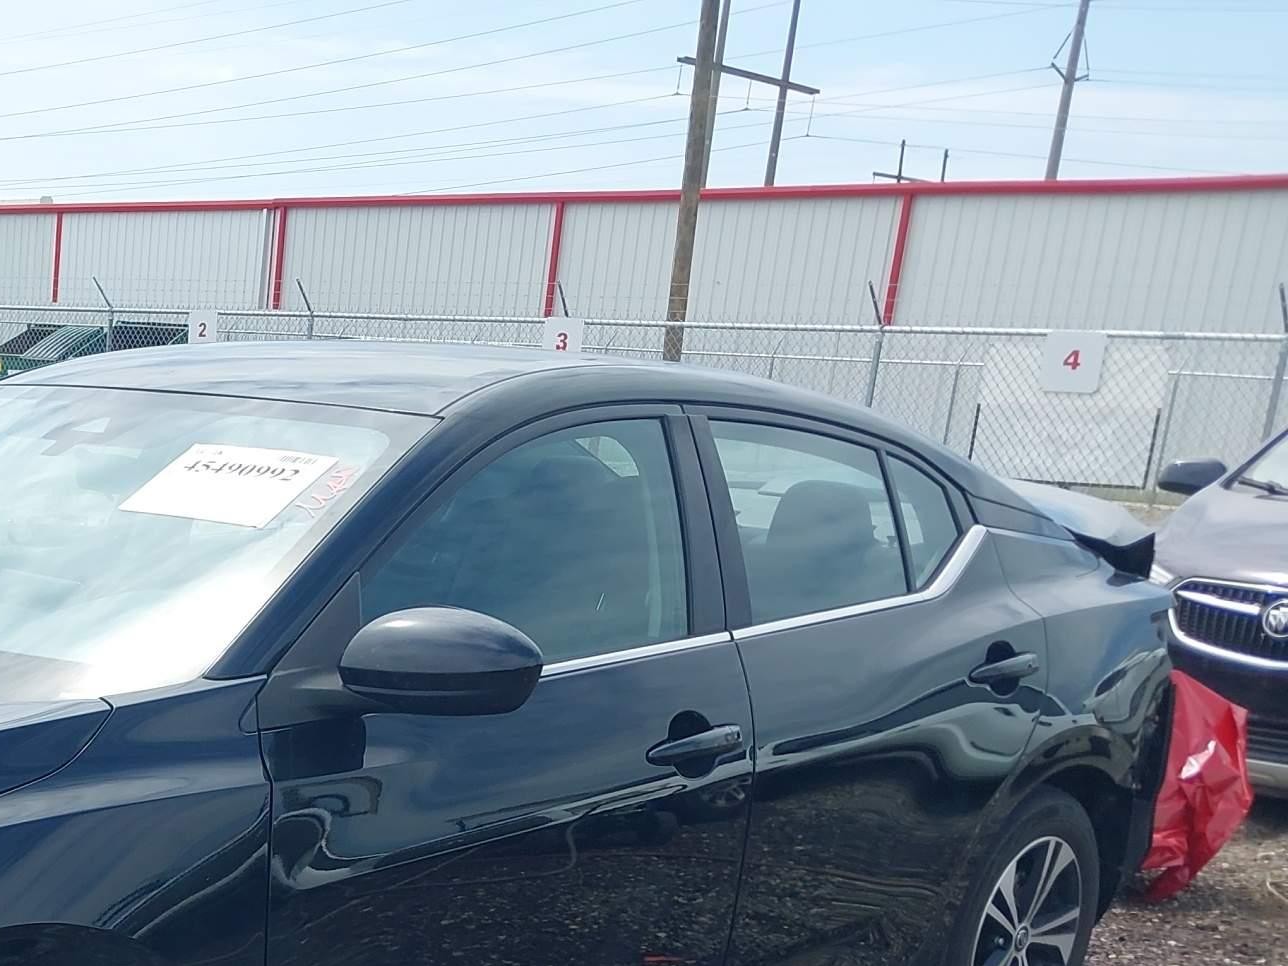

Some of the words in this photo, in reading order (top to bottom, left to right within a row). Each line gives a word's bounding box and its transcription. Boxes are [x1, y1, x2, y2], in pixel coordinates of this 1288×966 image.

[198, 322, 207, 337] 2
[555, 332, 568, 351] 3
[1062, 349, 1081, 370] 4
